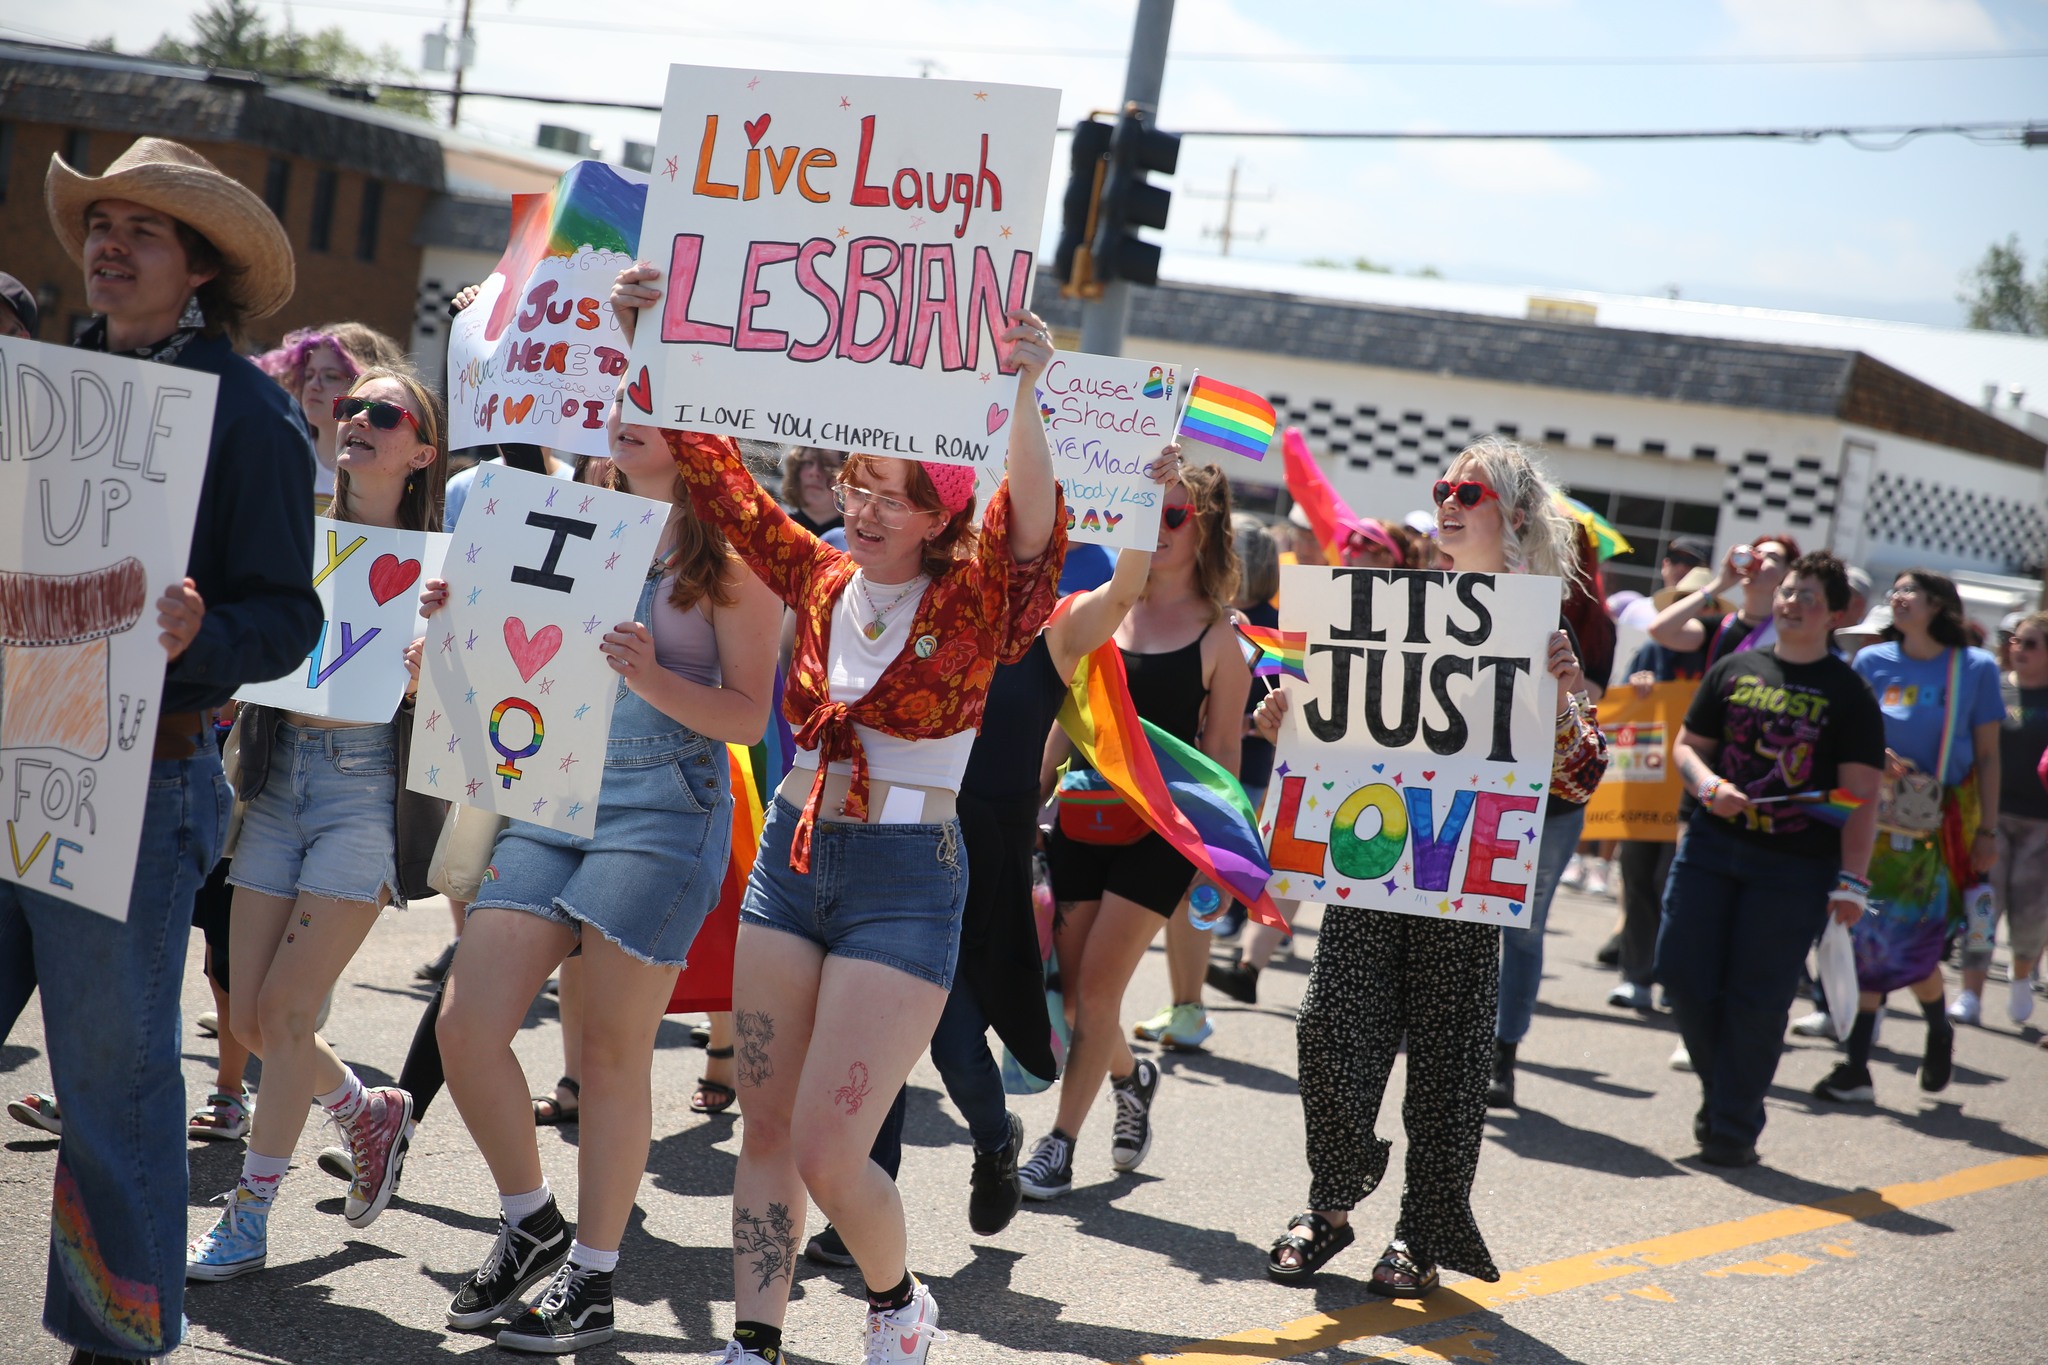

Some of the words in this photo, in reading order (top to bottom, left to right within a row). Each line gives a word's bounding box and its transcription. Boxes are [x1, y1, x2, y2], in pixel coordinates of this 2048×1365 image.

[693, 114, 837, 204] Live
[850, 115, 1001, 239] Laugh
[661, 233, 1033, 376] LESBIAN
[674, 404, 693, 423] I
[700, 406, 755, 429] LOVE
[767, 412, 816, 444] YOU,
[821, 422, 923, 453] CHAPPELL
[935, 434, 989, 461] ROAN
[1052, 396, 1161, 437] Shade
[40, 478, 132, 548] UP
[1121, 486, 1157, 507] Less
[511, 511, 597, 594] I
[1330, 568, 1496, 646] IT'S
[1303, 644, 1531, 763] JUST
[14, 758, 97, 835] FOR
[1269, 776, 1540, 903] LOVE
